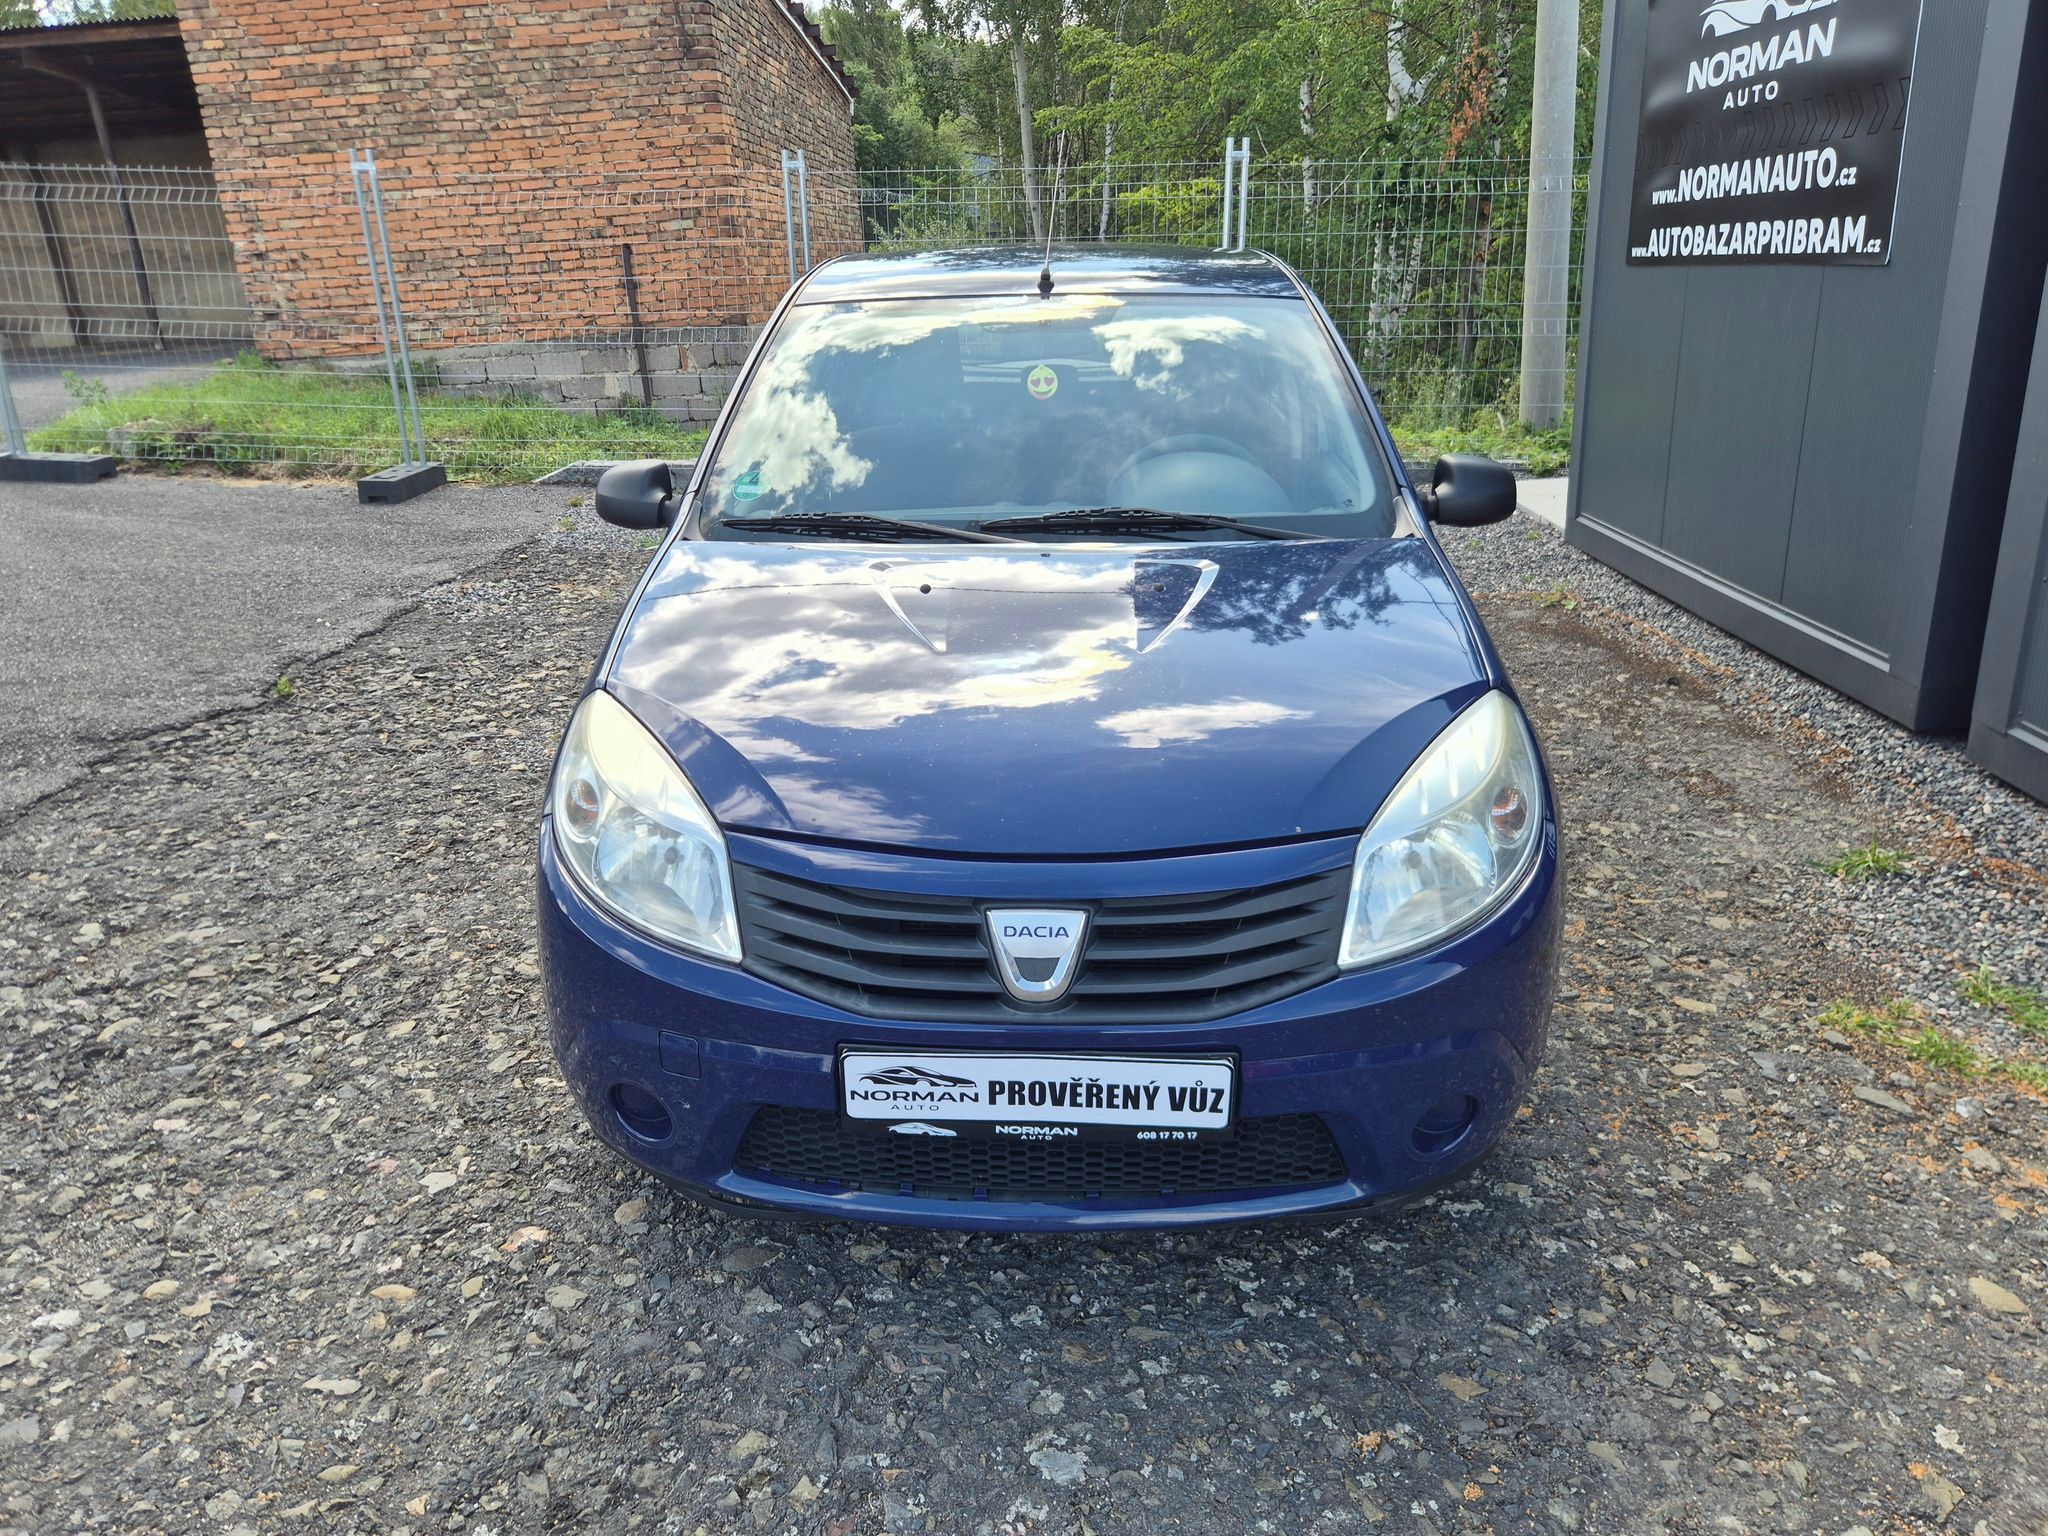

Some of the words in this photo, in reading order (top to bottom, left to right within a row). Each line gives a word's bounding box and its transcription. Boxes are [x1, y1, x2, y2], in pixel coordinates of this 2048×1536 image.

[1686, 18, 1838, 94] NORMAN
[1722, 80, 1779, 111] AUTO
[1652, 147, 1857, 205] www.NORMANAUTO.cz
[1003, 925, 1070, 938] DACIA
[850, 1090, 980, 1103] NORMAN
[988, 1076, 1161, 1111] PROVĚŘENÝ
[1167, 1080, 1225, 1114] VŮZ
[891, 1104, 940, 1112] AUTO
[995, 1125, 1078, 1136] NORMAN
[1136, 1131, 1157, 1140] 608
[1159, 1131, 1170, 1140] 17
[1171, 1131, 1185, 1140] 70
[1187, 1131, 1198, 1140] 17
